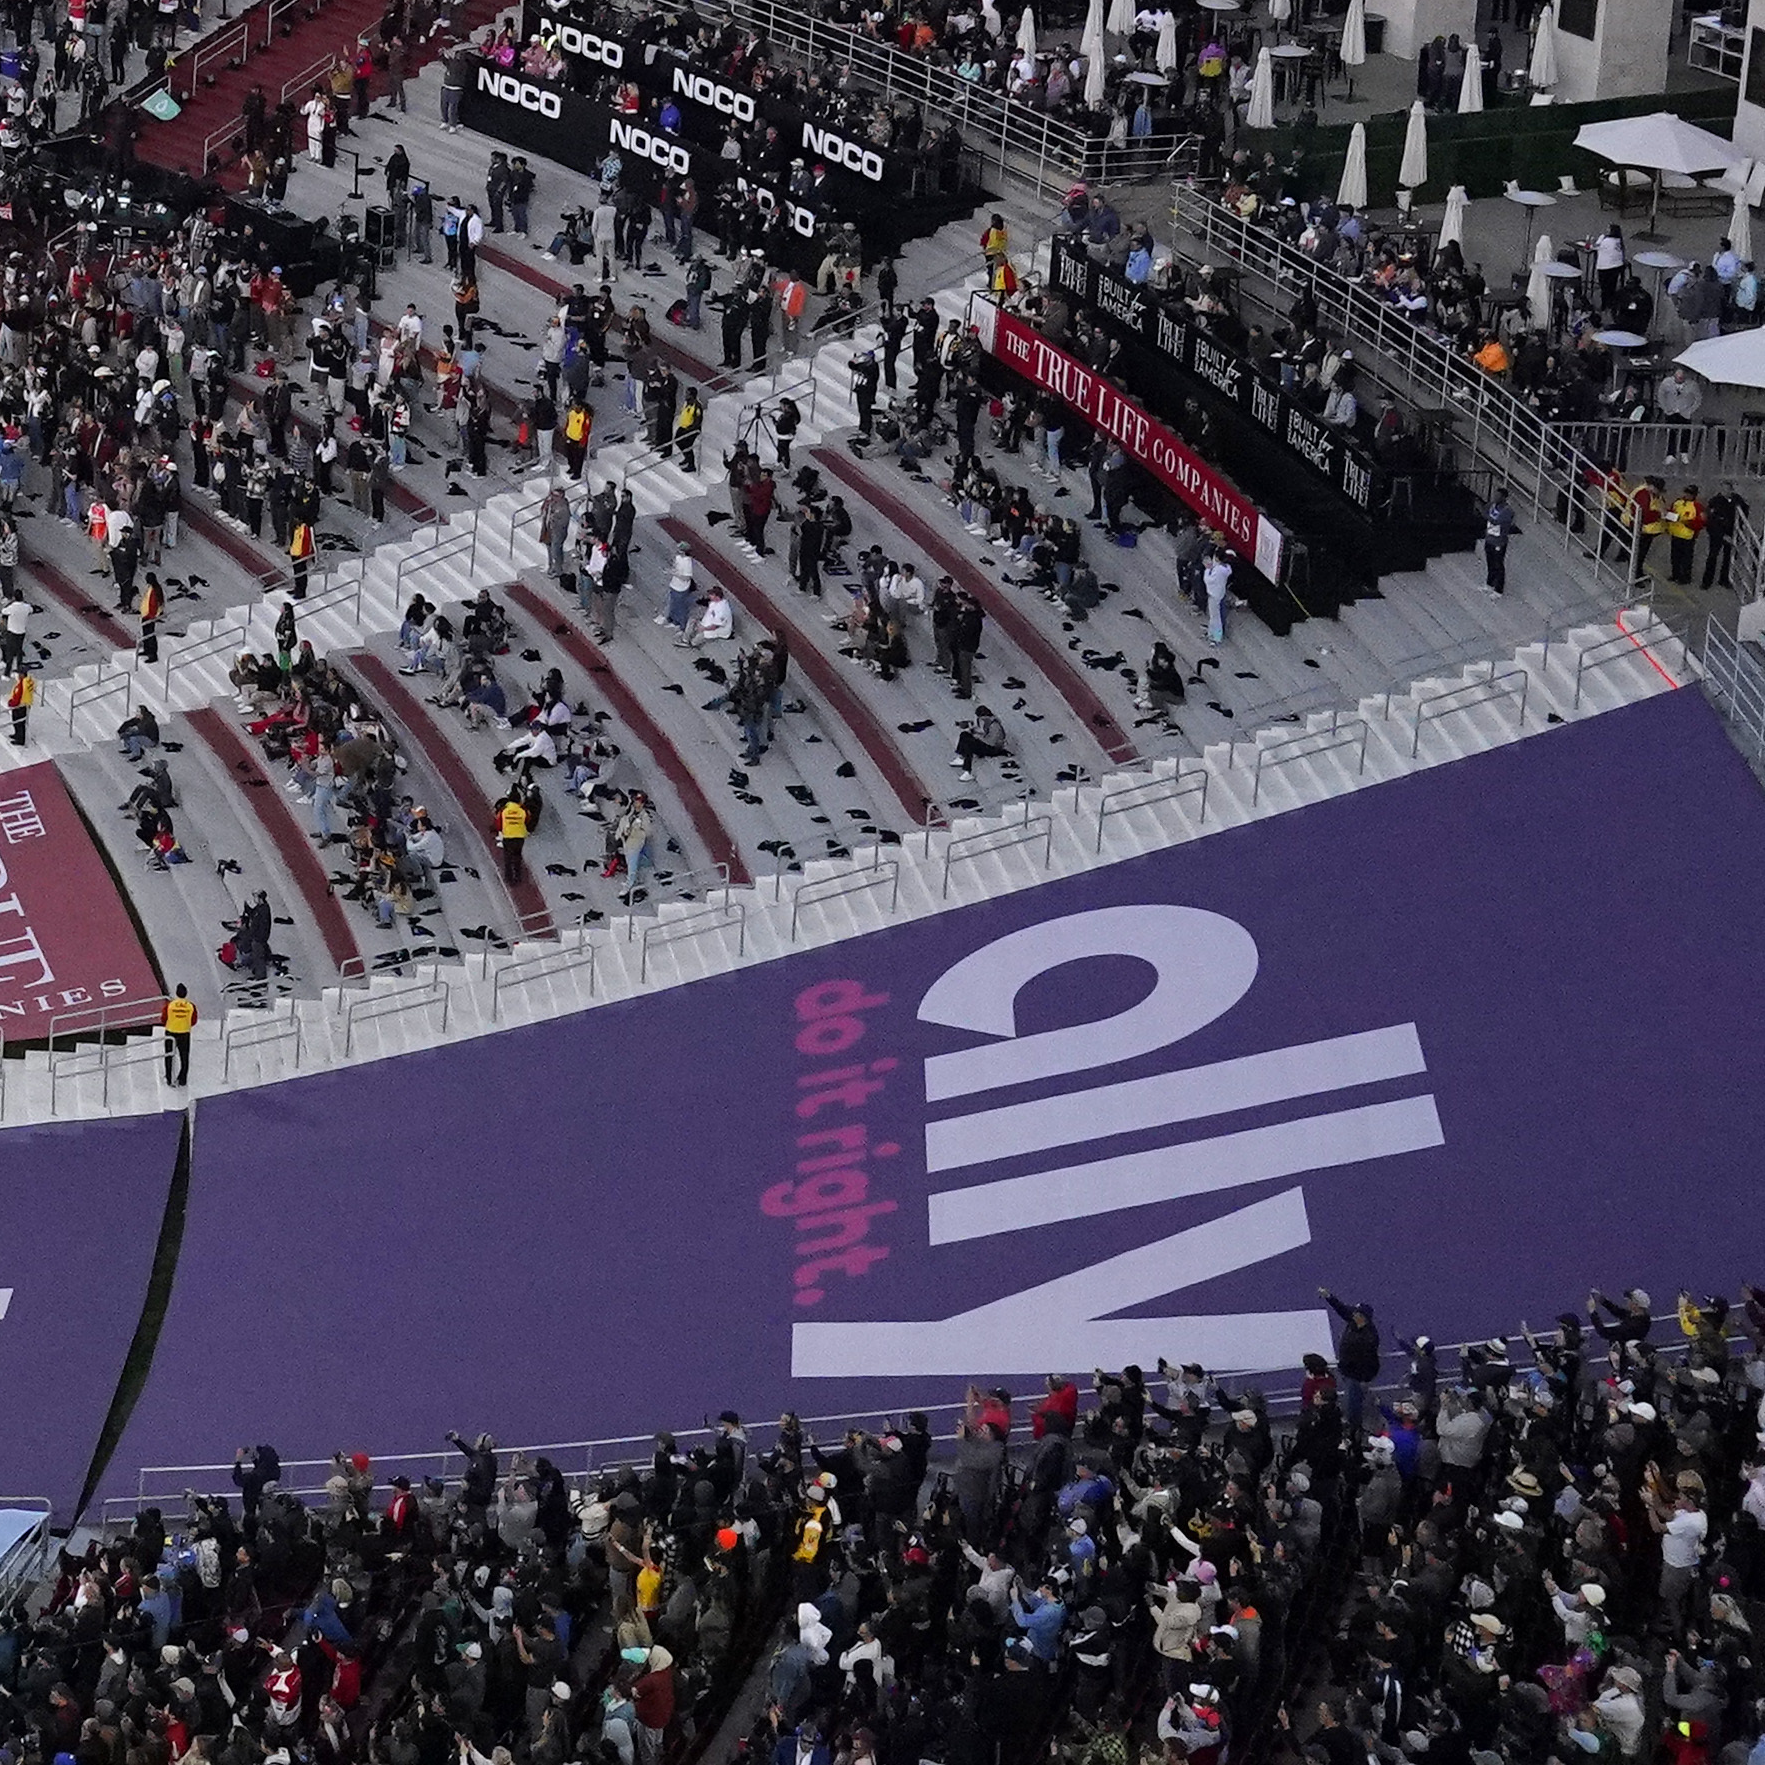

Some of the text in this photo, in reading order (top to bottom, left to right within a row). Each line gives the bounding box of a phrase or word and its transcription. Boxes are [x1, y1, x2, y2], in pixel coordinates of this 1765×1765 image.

[477, 66, 562, 119] NOCO
[673, 67, 754, 122] NOCO
[609, 118, 690, 175] NOCO
[801, 121, 883, 181] NOCO
[1004, 330, 1251, 544] THE TRUE LIFE COMPANIES
[759, 979, 901, 1306] do it right.
[791, 903, 1445, 1378] ally
